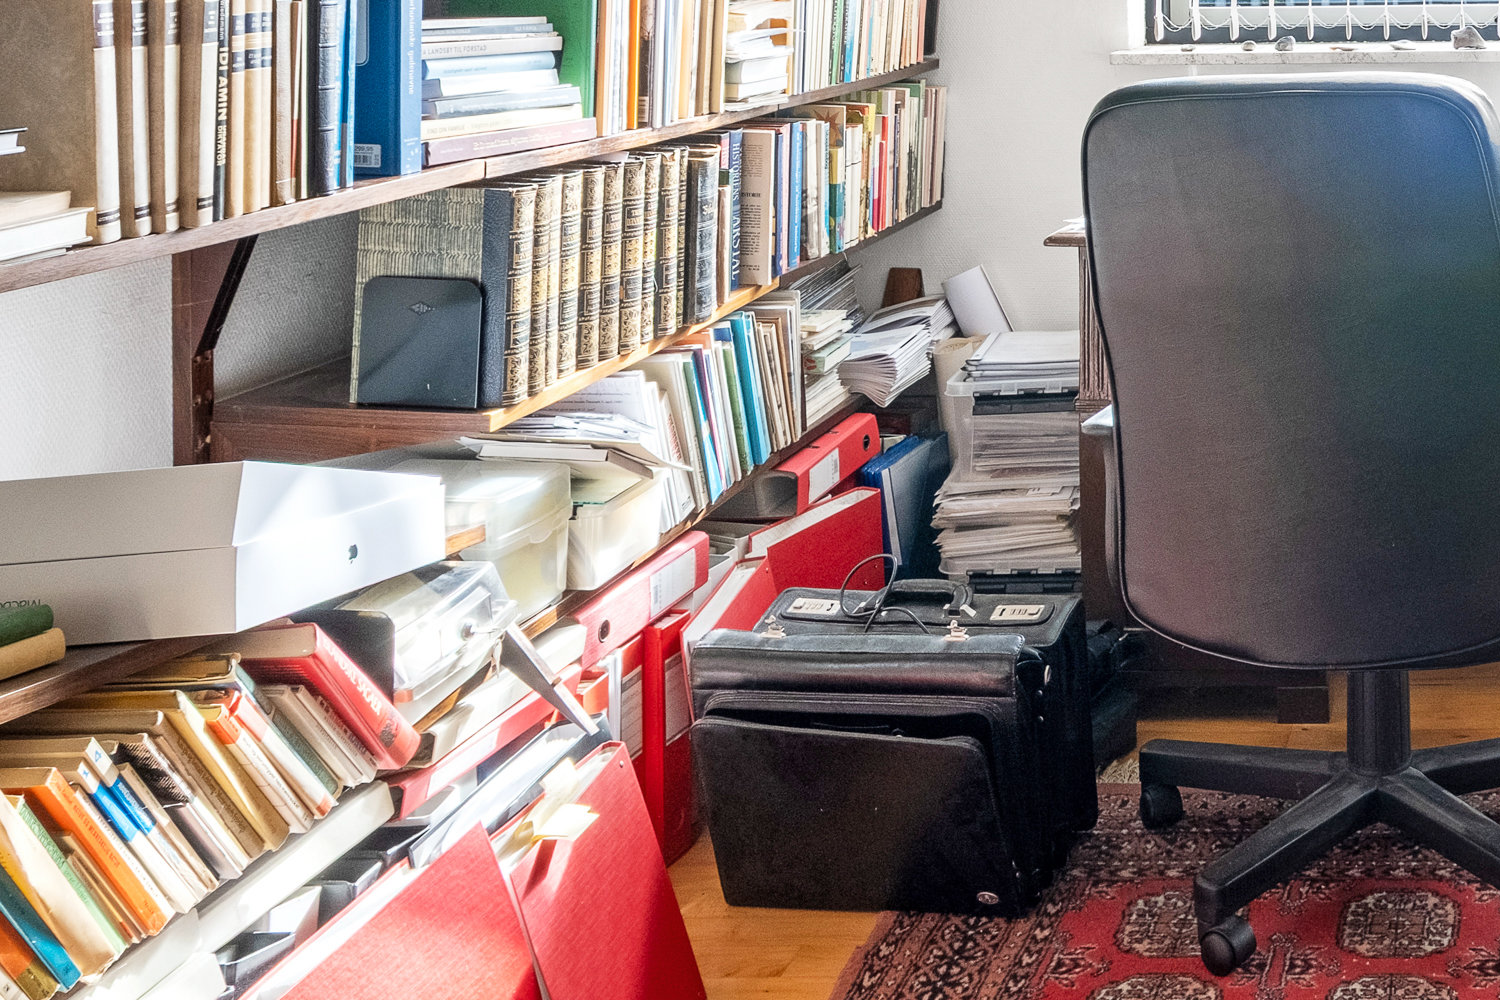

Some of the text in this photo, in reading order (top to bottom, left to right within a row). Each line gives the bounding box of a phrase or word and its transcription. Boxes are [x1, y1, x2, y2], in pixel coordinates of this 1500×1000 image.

[219, 47, 229, 70] IDI
[217, 76, 229, 121] AMIN
[732, 143, 742, 201] HISTORIENS
